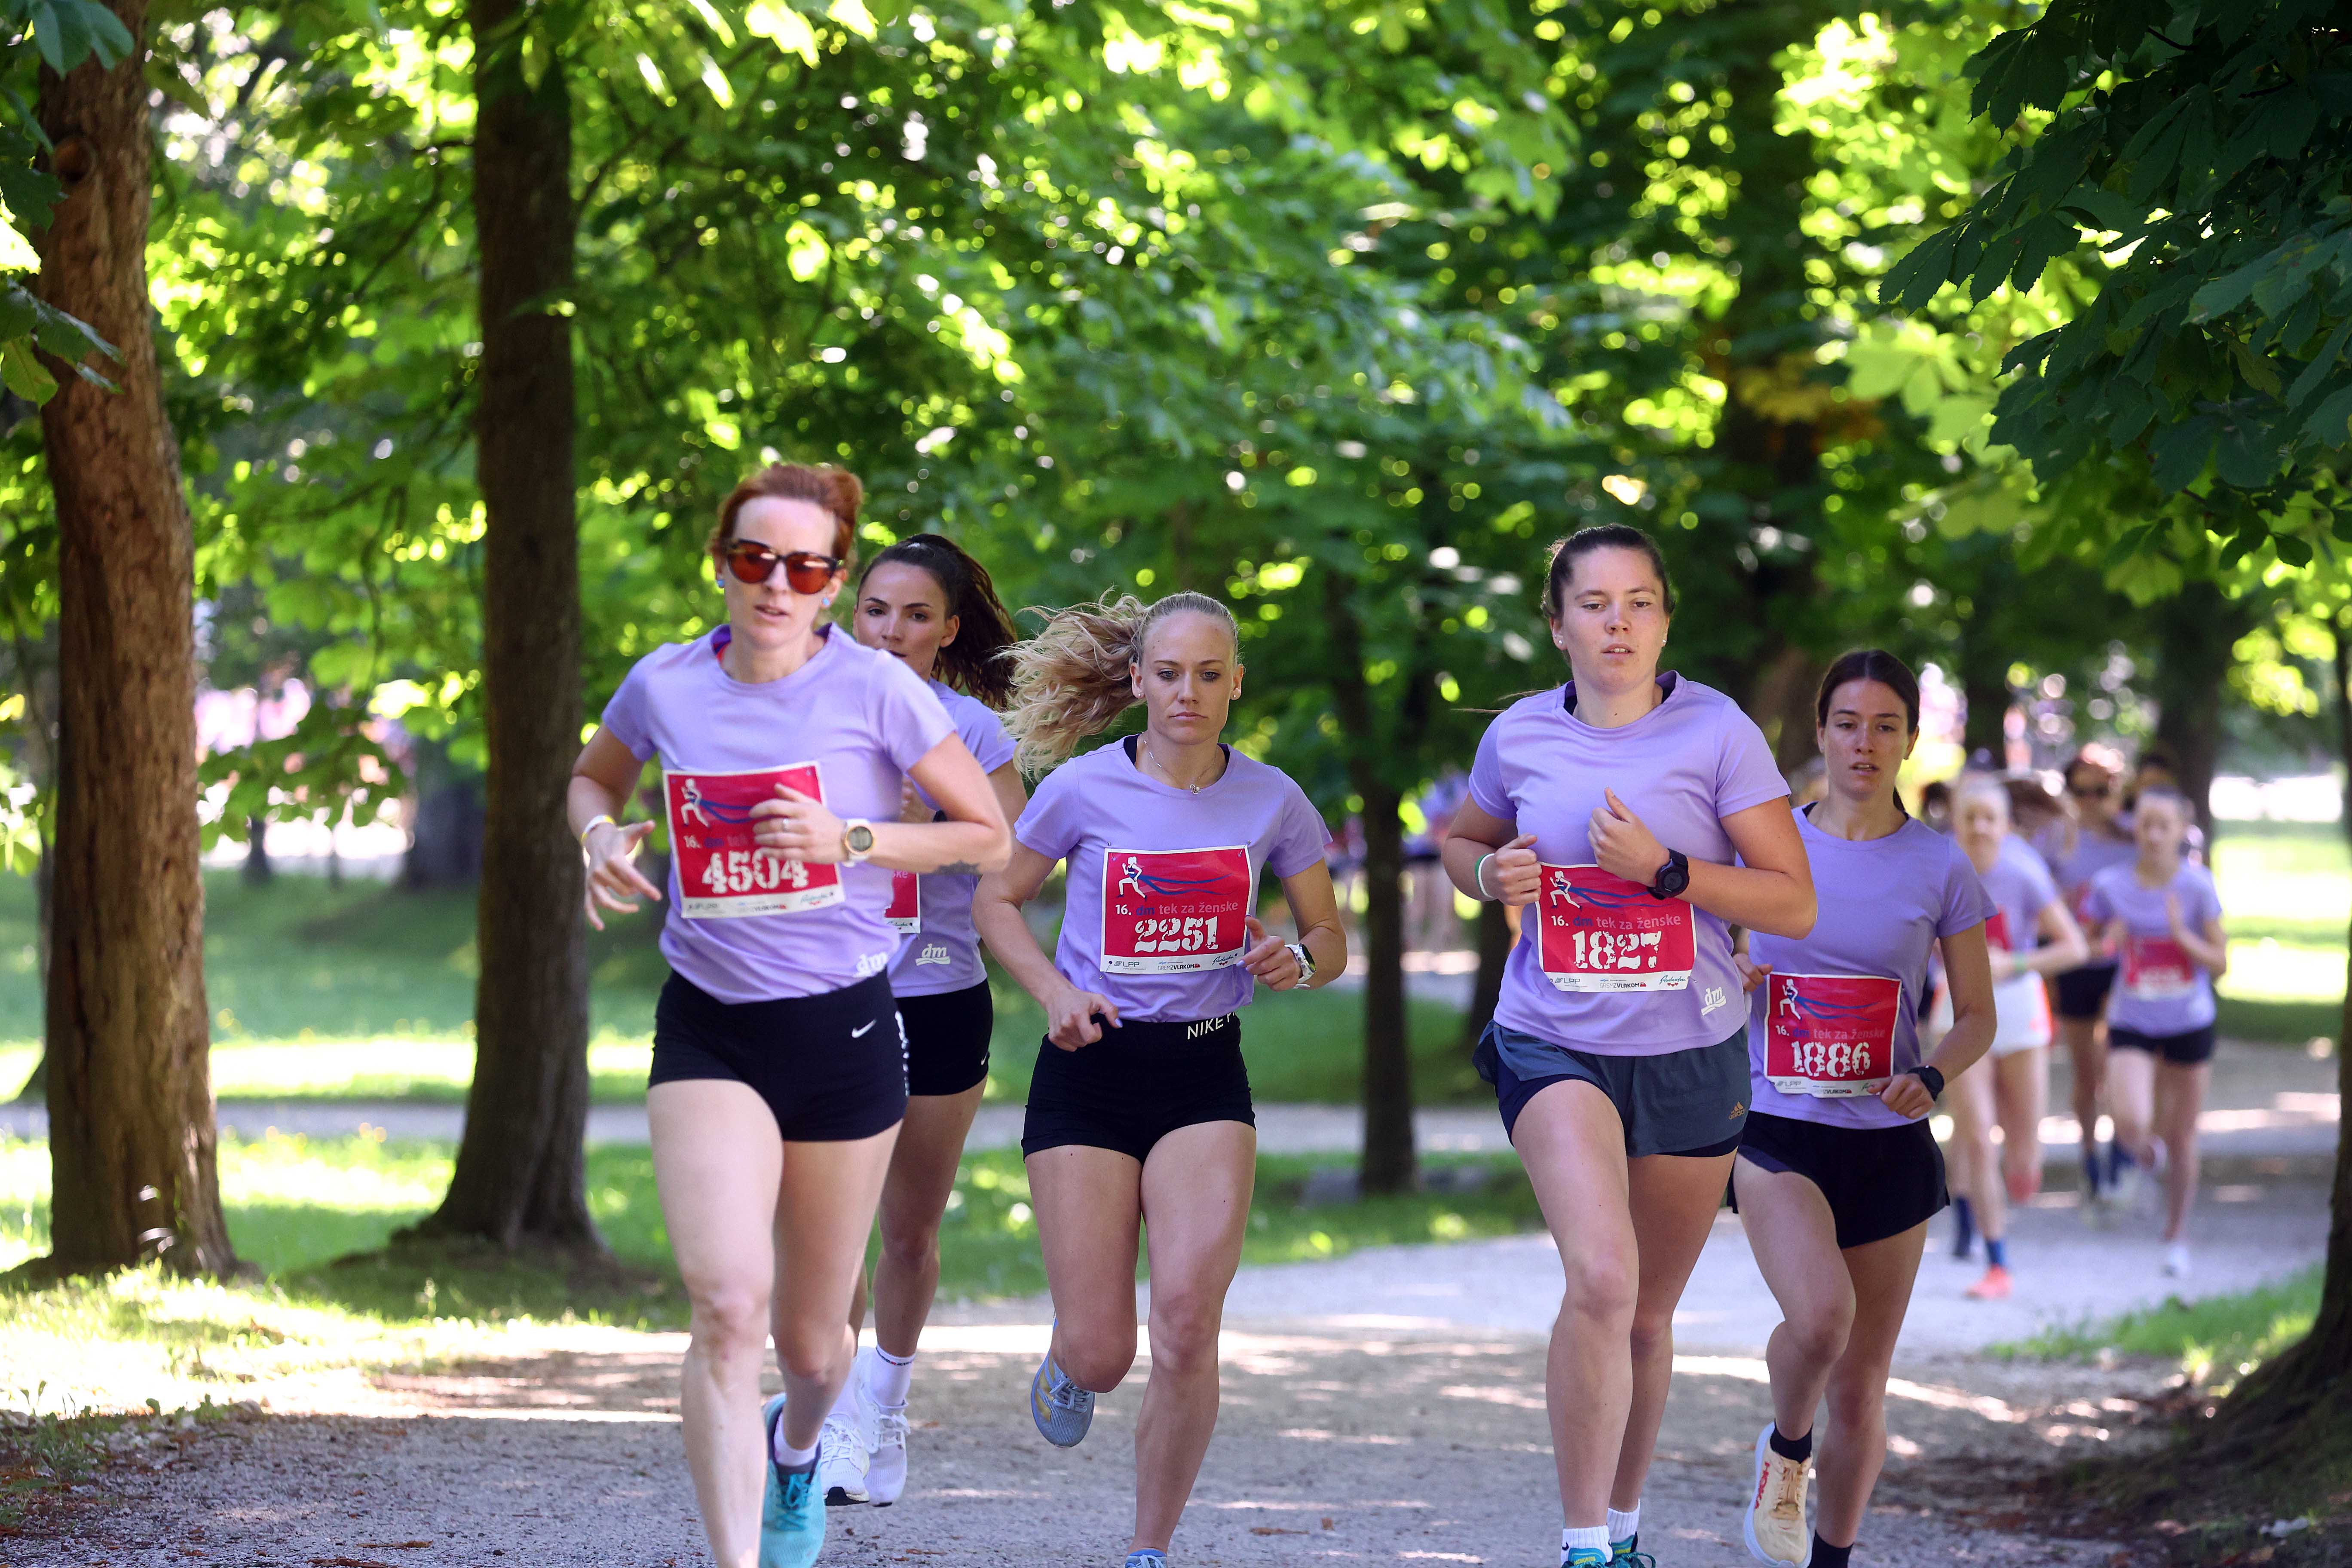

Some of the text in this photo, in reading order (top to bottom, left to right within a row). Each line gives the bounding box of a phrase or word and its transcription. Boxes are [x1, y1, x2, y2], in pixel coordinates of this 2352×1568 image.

[702, 847, 808, 894] 4504
[1115, 901, 1238, 915] 16. dm tek za ženske
[1551, 914, 1681, 930] 16. dm tek za ženske
[1134, 916, 1219, 953] 2251
[922, 943, 947, 958] dm
[1572, 930, 1662, 970] 1827
[856, 952, 888, 974] dm
[1705, 986, 1723, 1006] dm
[1187, 1018, 1224, 1039] NIKE
[1776, 1025, 1790, 1036] 16.
[1793, 1028, 1809, 1038] dm
[1814, 1029, 1831, 1039] tek
[1791, 1041, 1871, 1077] 1886
